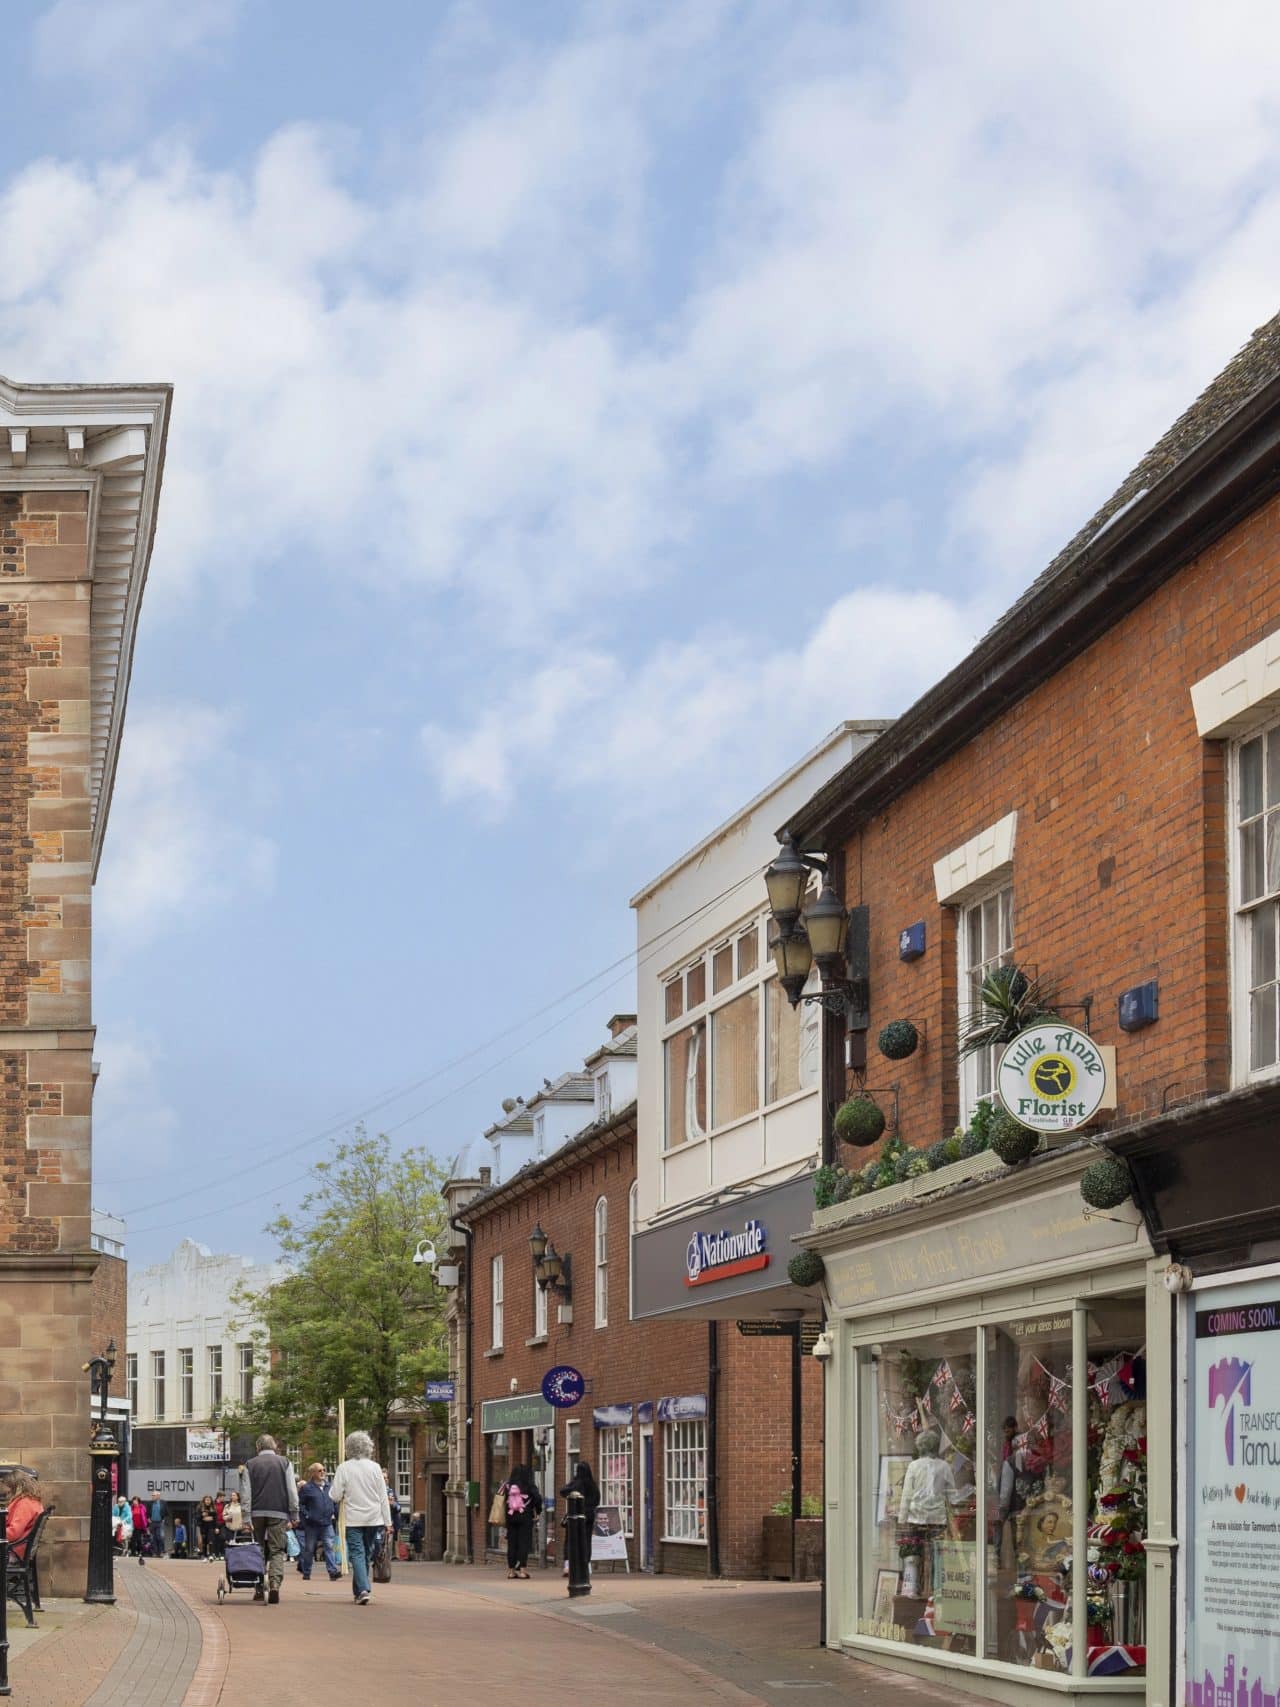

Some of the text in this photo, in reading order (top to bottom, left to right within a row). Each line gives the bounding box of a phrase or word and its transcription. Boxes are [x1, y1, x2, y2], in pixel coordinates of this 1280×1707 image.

[1055, 1031, 1102, 1077] Anne
[1017, 1098, 1086, 1117] Florist
[702, 1220, 762, 1268] Nationwide
[1208, 1311, 1246, 1333] COMING
[147, 1480, 195, 1491] BURTON
